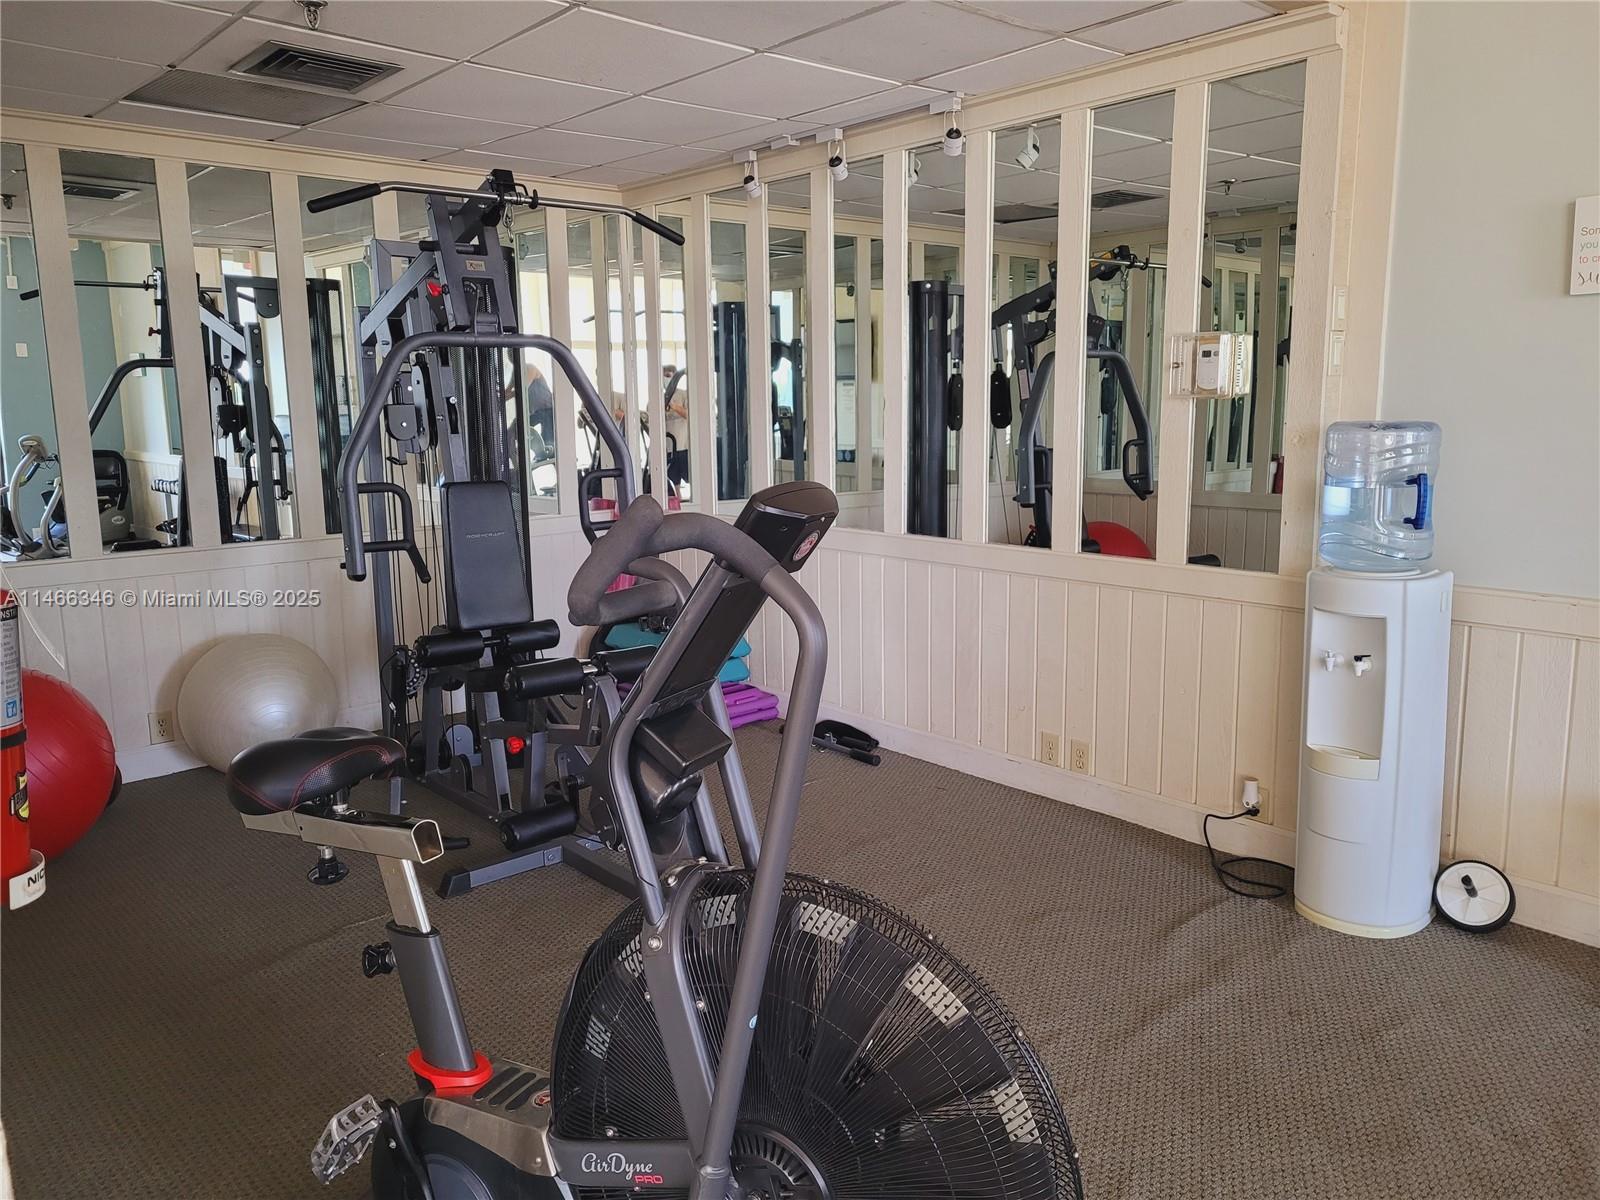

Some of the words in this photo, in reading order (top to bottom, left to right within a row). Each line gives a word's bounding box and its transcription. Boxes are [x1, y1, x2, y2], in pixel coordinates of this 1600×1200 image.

[1580, 241, 1599, 253] you
[1579, 256, 1589, 264] to
[581, 1152, 653, 1180] AirDyne
[634, 1175, 663, 1184] PRO
